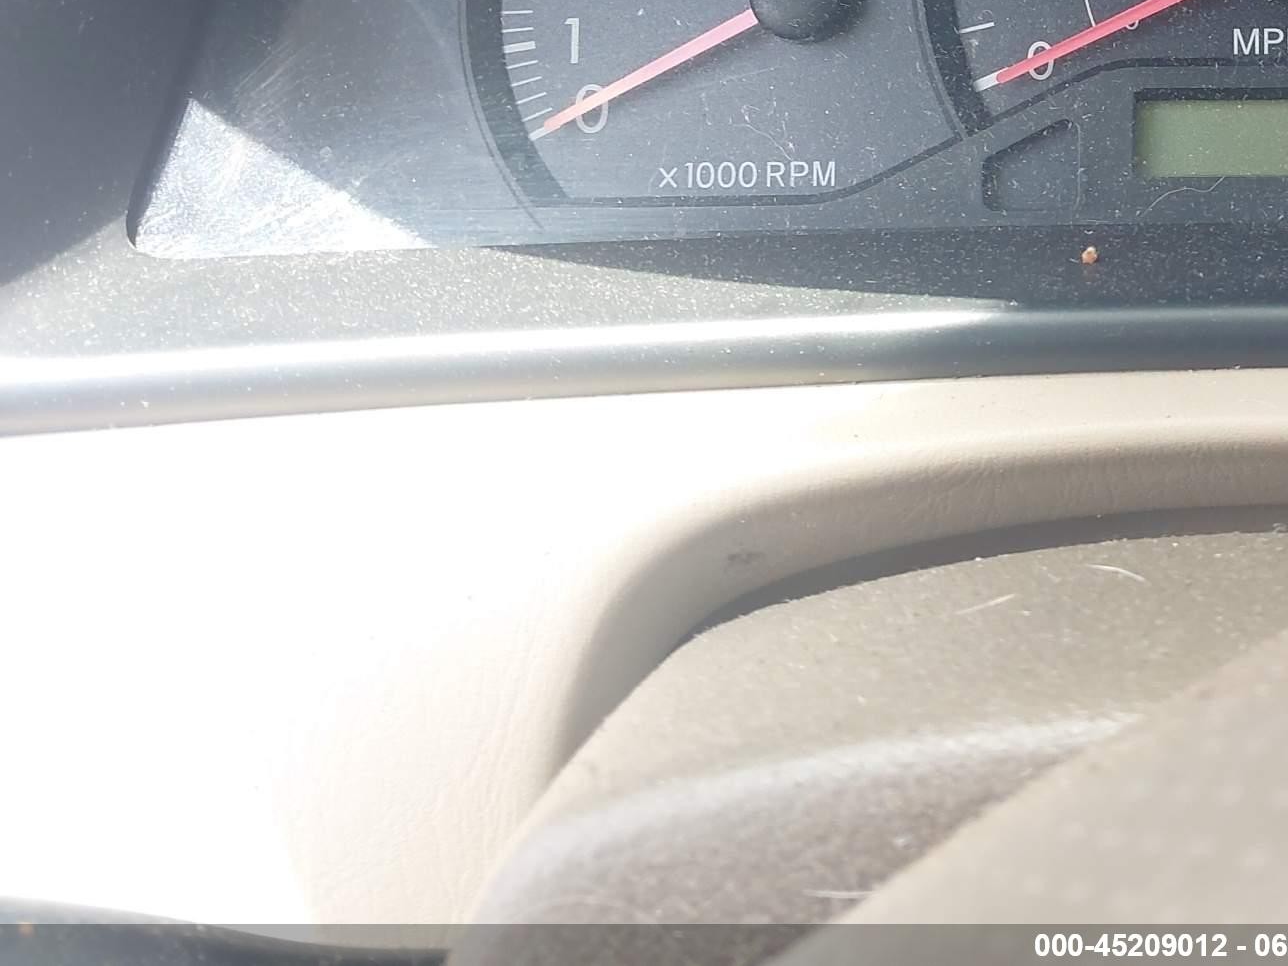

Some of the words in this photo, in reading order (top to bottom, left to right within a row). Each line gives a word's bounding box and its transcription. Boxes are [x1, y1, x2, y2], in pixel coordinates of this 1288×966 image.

[564, 17, 580, 64] 1
[1026, 41, 1055, 81] 0
[574, 83, 609, 134] 0
[658, 161, 758, 190] x1000
[765, 161, 837, 188] RPM
